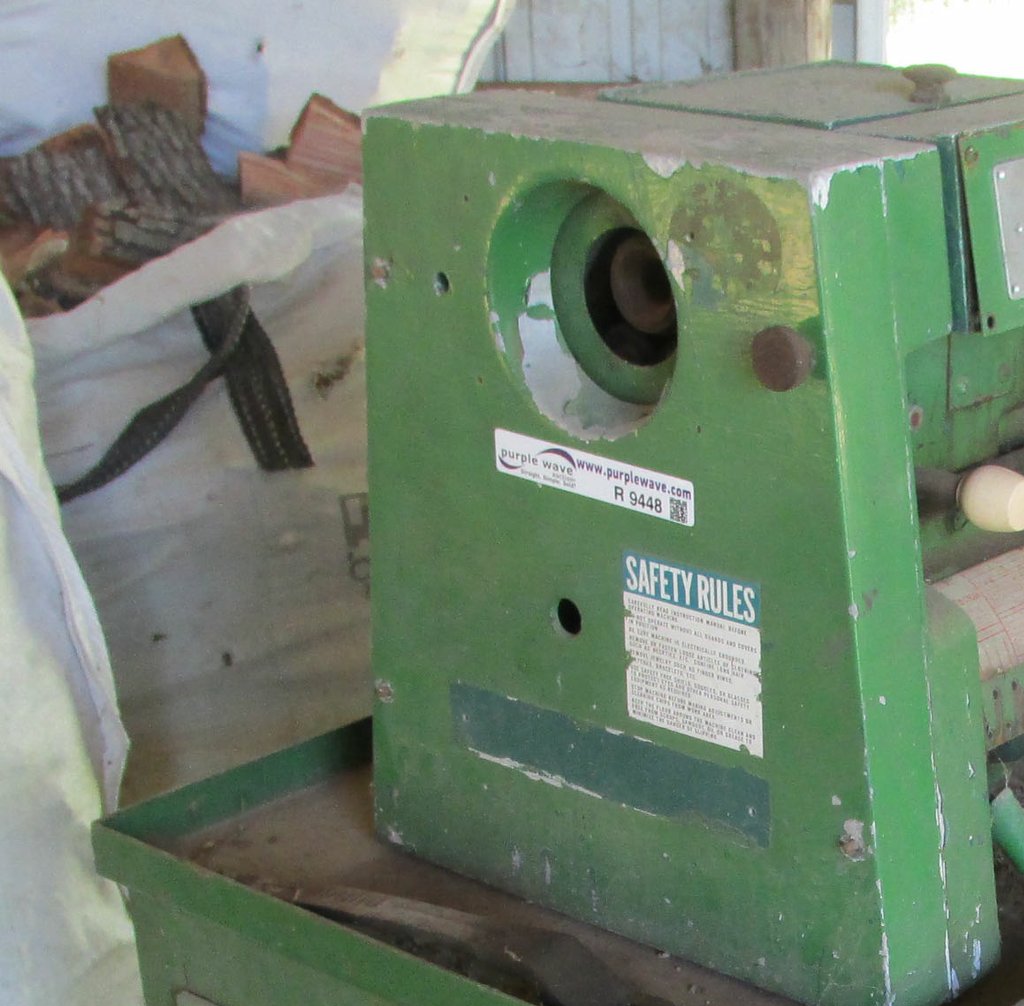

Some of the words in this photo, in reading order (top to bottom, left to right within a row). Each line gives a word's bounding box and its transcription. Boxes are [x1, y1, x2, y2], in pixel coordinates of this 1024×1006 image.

[501, 448, 538, 466] purple
[543, 461, 574, 476] wave
[576, 459, 692, 501] www.purplewave.com
[614, 486, 624, 501] R
[629, 492, 663, 514] 9448
[625, 555, 693, 605] SAFETY
[697, 574, 755, 623] RULES
